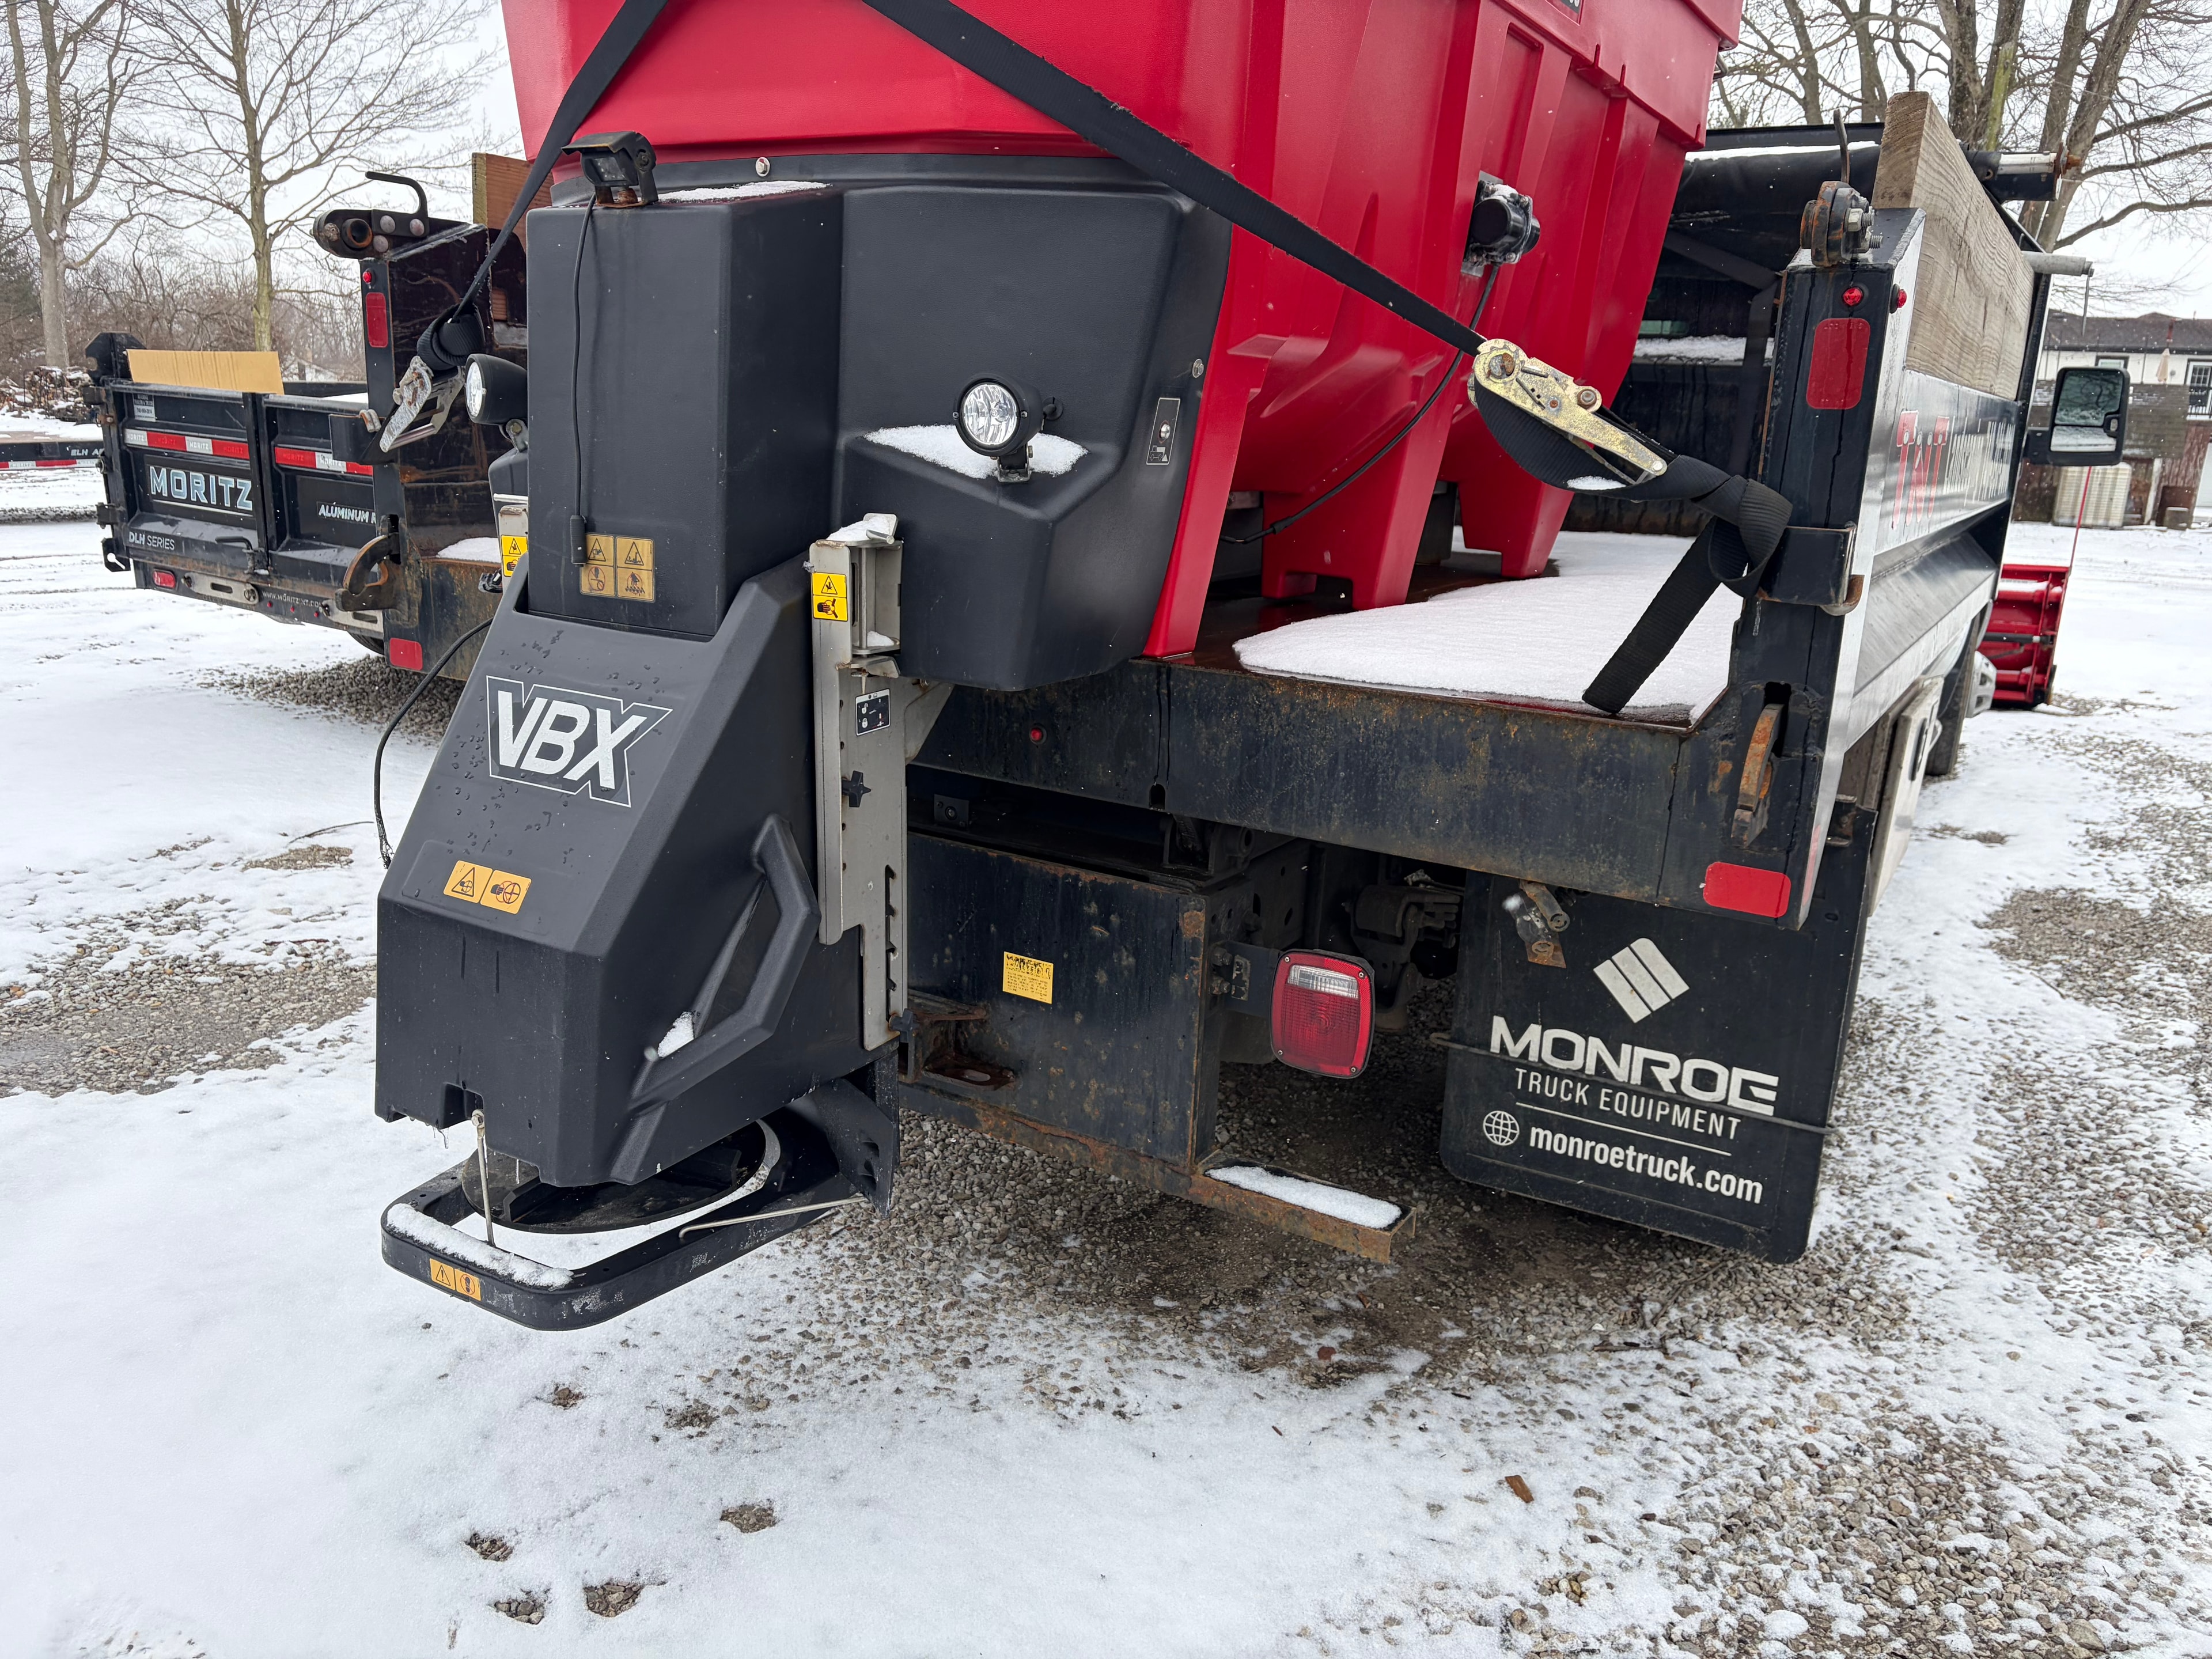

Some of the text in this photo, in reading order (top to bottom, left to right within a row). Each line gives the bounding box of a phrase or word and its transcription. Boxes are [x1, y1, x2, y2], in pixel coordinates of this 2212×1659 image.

[190, 441, 209, 449] MORITZ
[1892, 410, 1949, 530] TNT
[150, 466, 253, 511] MORITZ
[319, 504, 369, 524] ALUMINUM
[129, 531, 175, 551] DLH SERIES
[498, 691, 647, 790] VBX
[1490, 1015, 1779, 1116] MONROE
[1514, 1067, 1741, 1140] TRUCK EQUIPMENT
[1529, 1126, 1764, 1205] monroetruck.com
